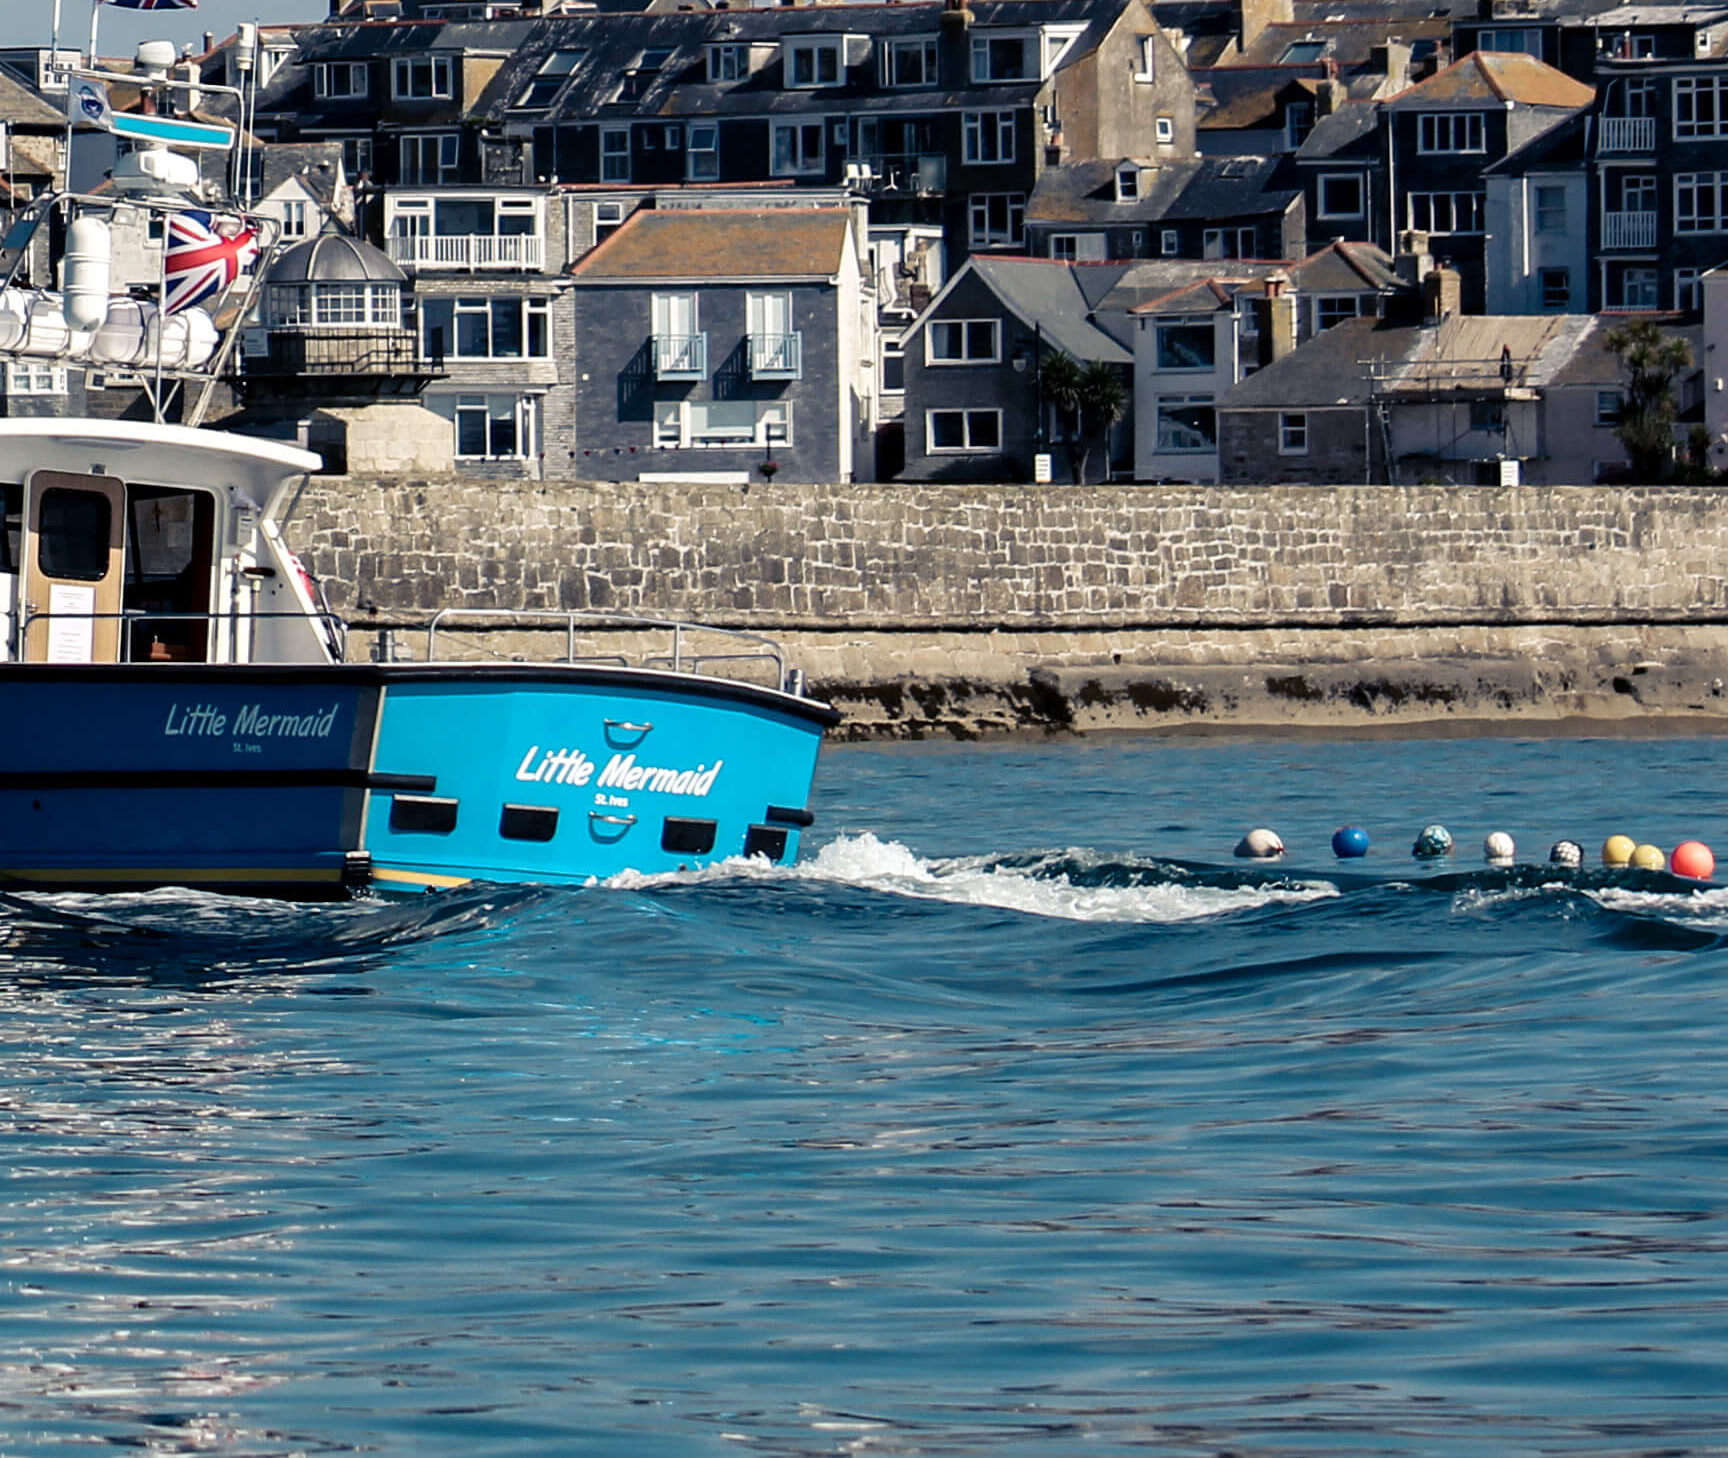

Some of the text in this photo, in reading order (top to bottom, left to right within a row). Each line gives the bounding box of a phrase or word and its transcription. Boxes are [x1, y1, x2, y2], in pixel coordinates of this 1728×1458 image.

[164, 703, 339, 737] Little Mermaid
[245, 743, 262, 753] Ives
[515, 745, 723, 796] Little Mermaid
[608, 794, 629, 807] Ives
